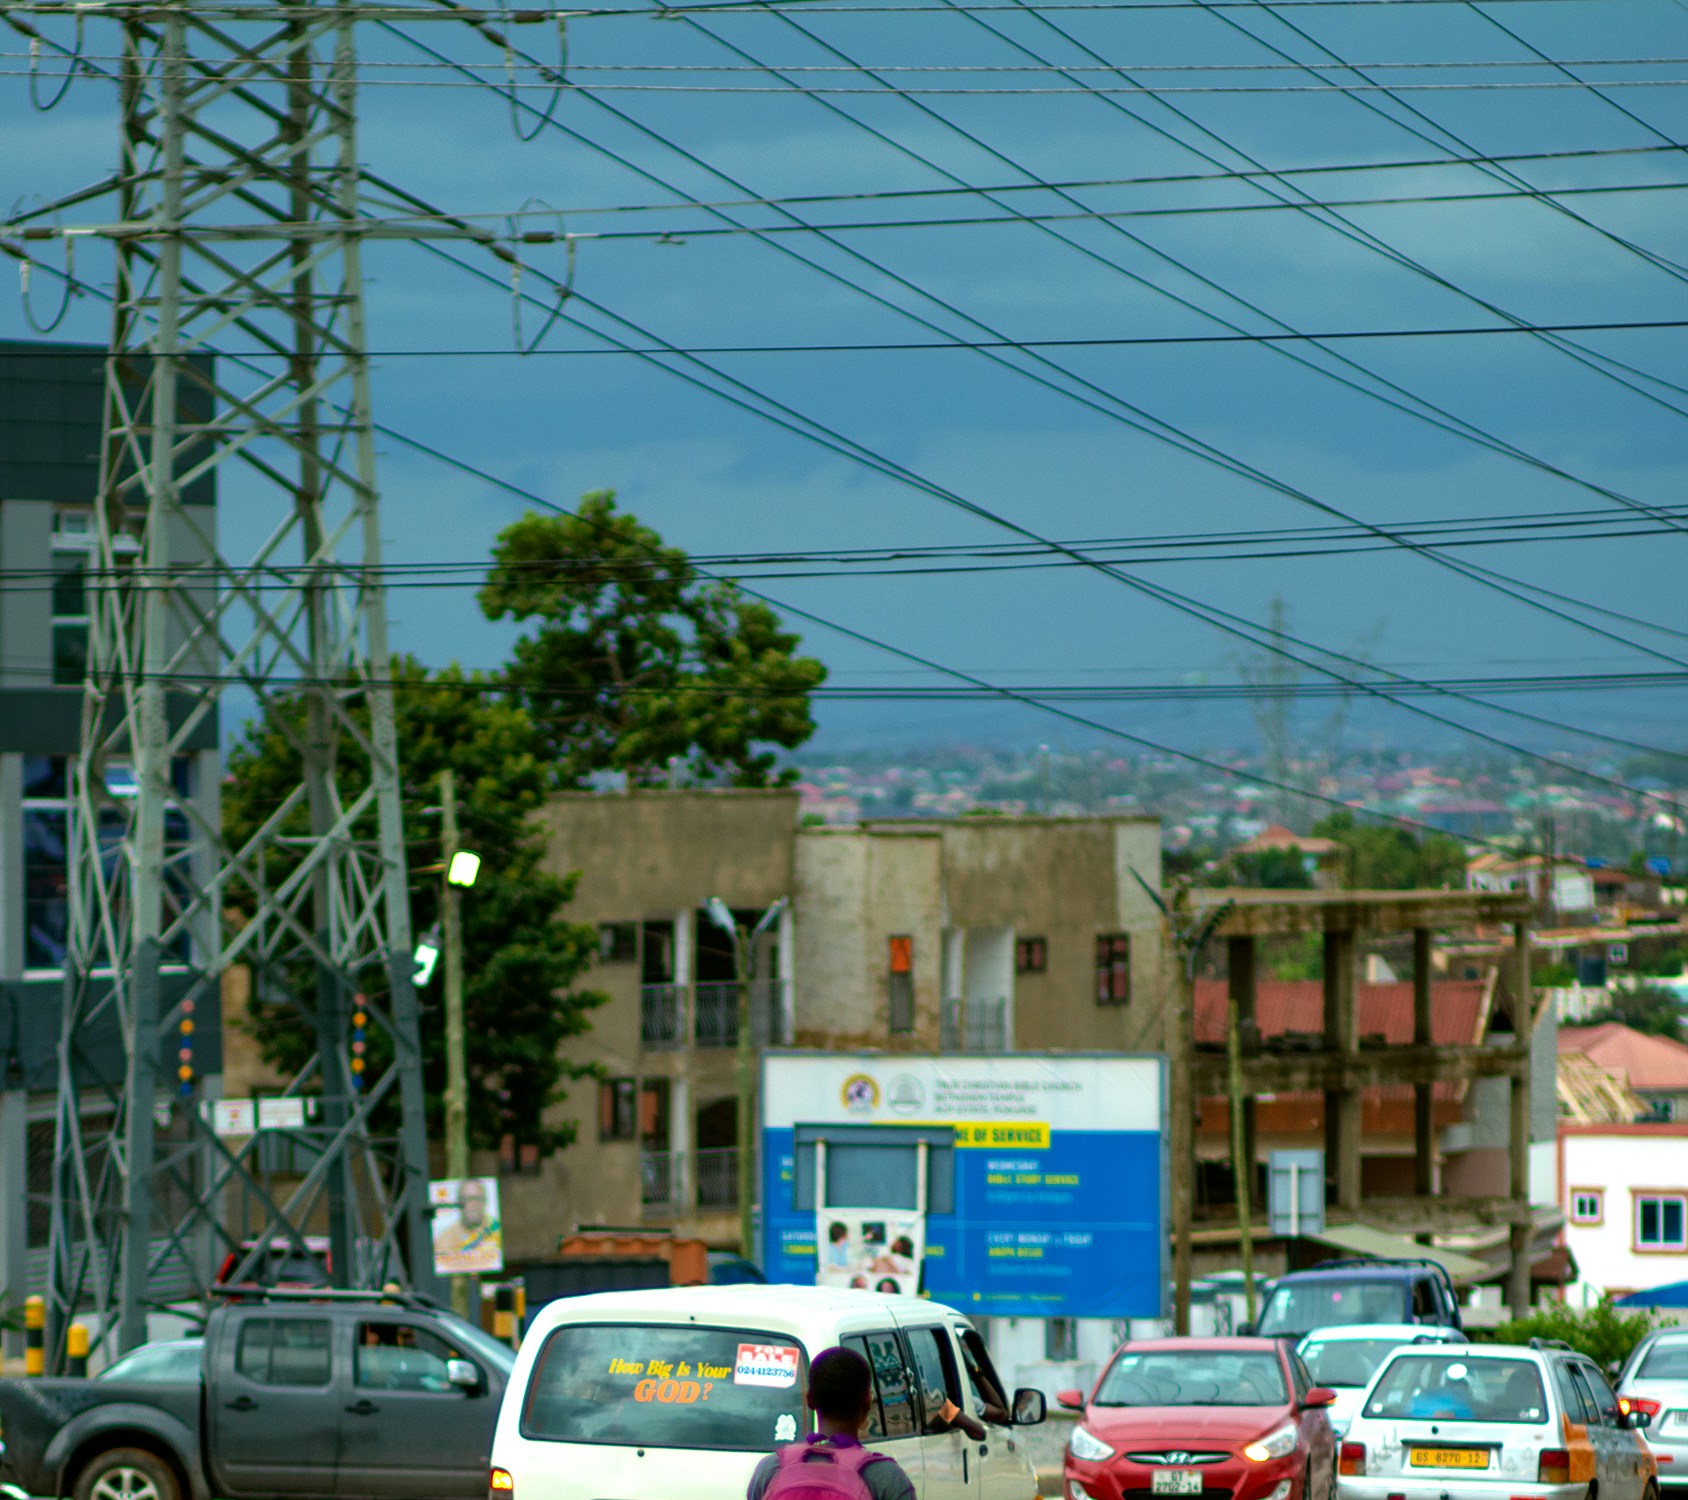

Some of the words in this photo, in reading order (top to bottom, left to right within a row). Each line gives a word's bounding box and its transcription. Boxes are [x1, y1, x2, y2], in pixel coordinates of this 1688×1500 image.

[974, 1128, 987, 1142] OF
[992, 1128, 1042, 1143] SERVICE
[608, 1359, 643, 1375] How
[646, 1360, 674, 1380] Big
[676, 1361, 691, 1377] Is
[697, 1362, 732, 1379] Your
